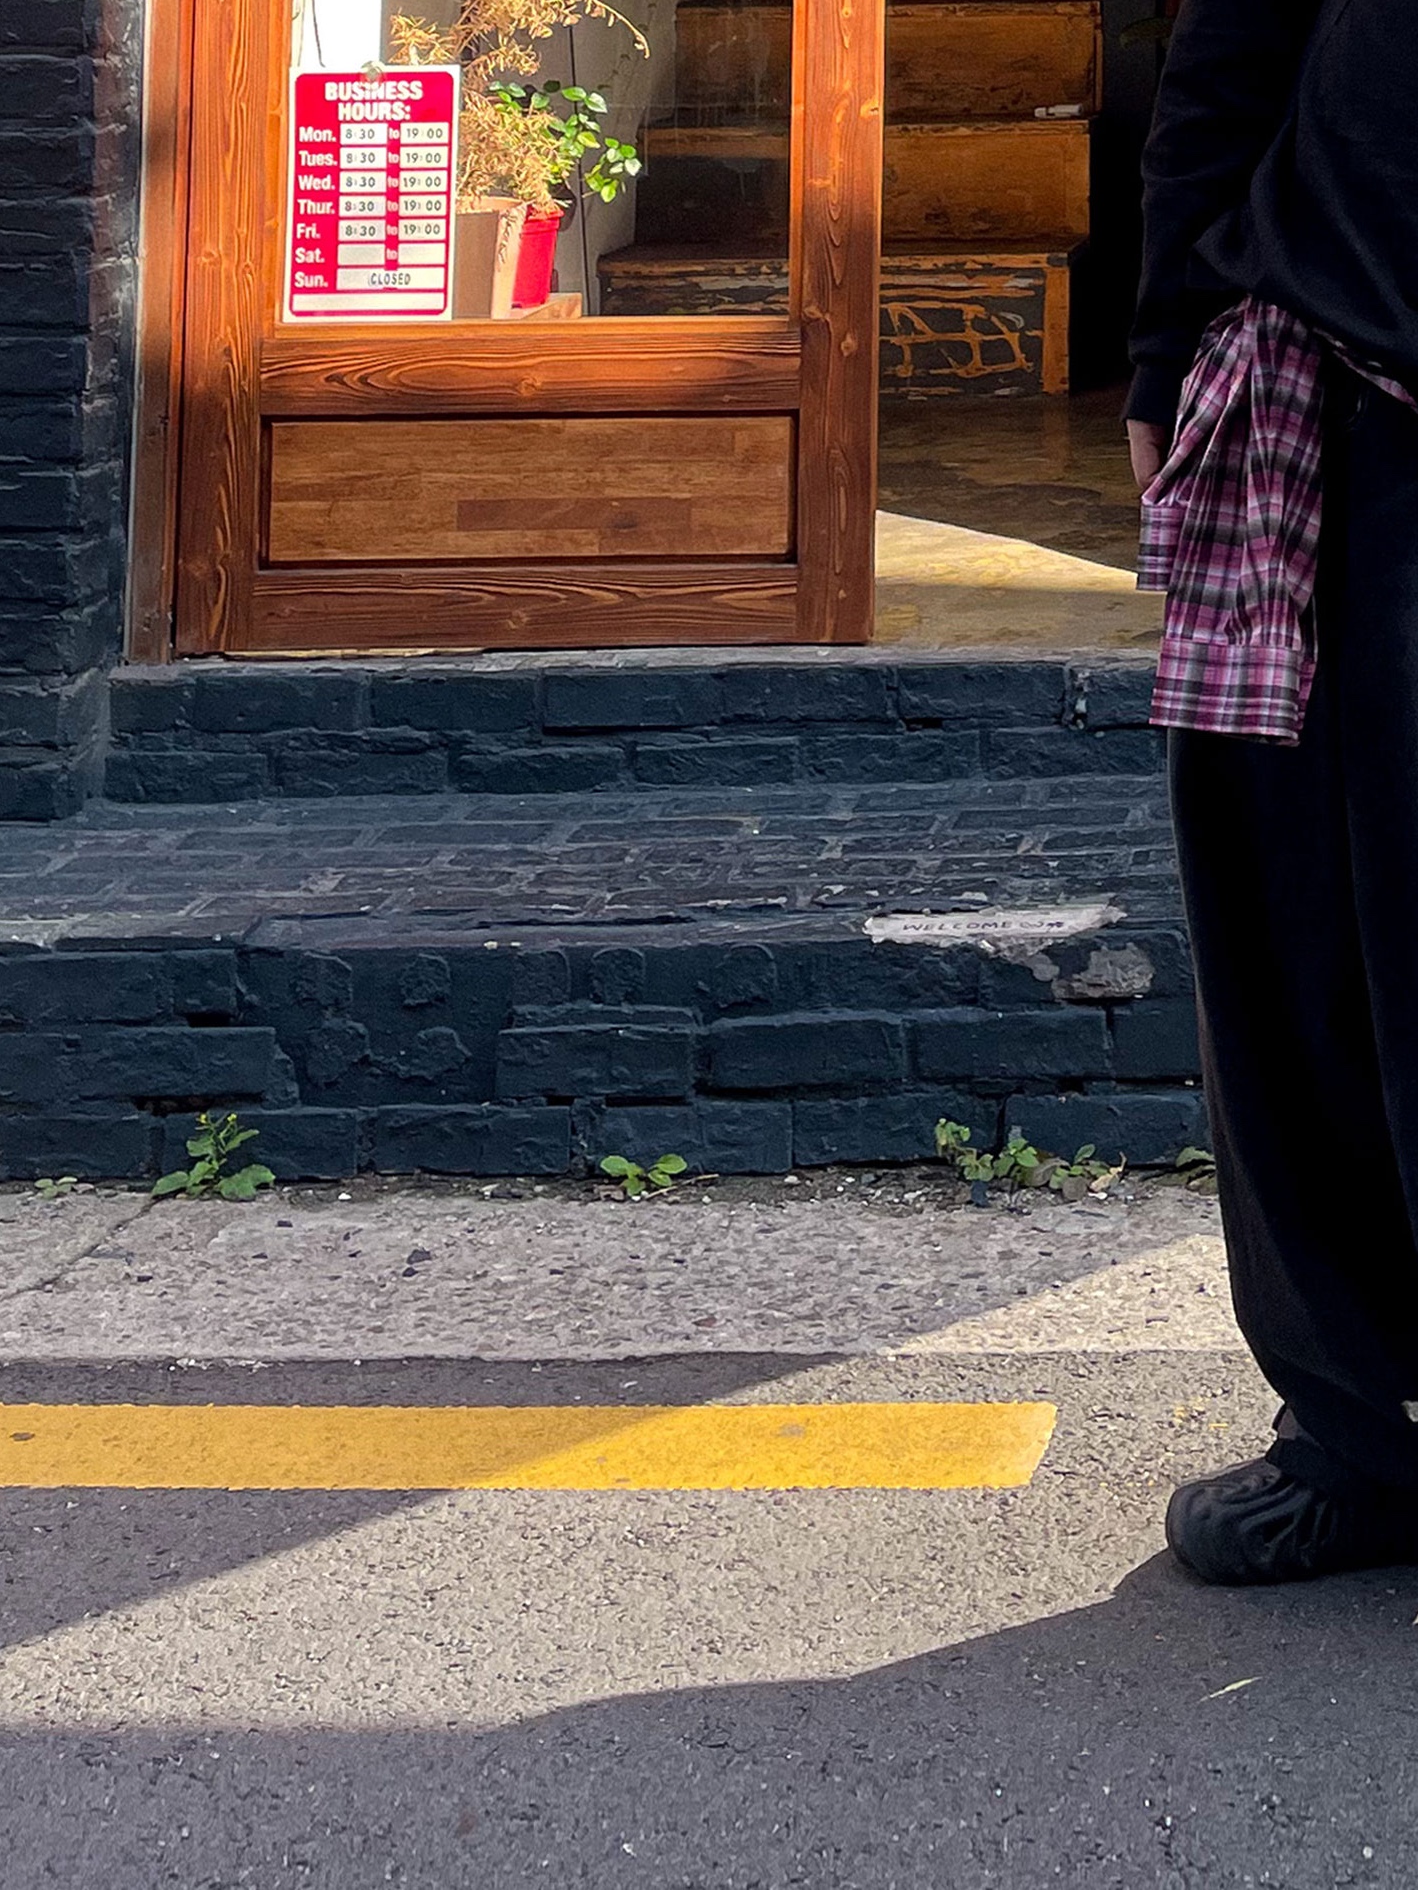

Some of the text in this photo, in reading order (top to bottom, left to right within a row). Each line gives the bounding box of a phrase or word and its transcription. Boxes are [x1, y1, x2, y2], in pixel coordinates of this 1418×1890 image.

[324, 80, 423, 101] BUSINESS
[337, 102, 411, 121] HOURS:
[299, 126, 337, 142] Mon.
[389, 127, 400, 139] to
[298, 150, 338, 166] Tues.
[388, 151, 399, 163] to
[298, 175, 335, 190] Wed.
[387, 175, 399, 188] to
[297, 199, 335, 214] Thur.
[387, 200, 399, 211] to
[296, 223, 321, 239] Fri.
[386, 224, 398, 236] to
[295, 247, 398, 263] Sat. to
[294, 272, 411, 288] Sun. CLOSED
[902, 921, 1012, 931] WELCOME
